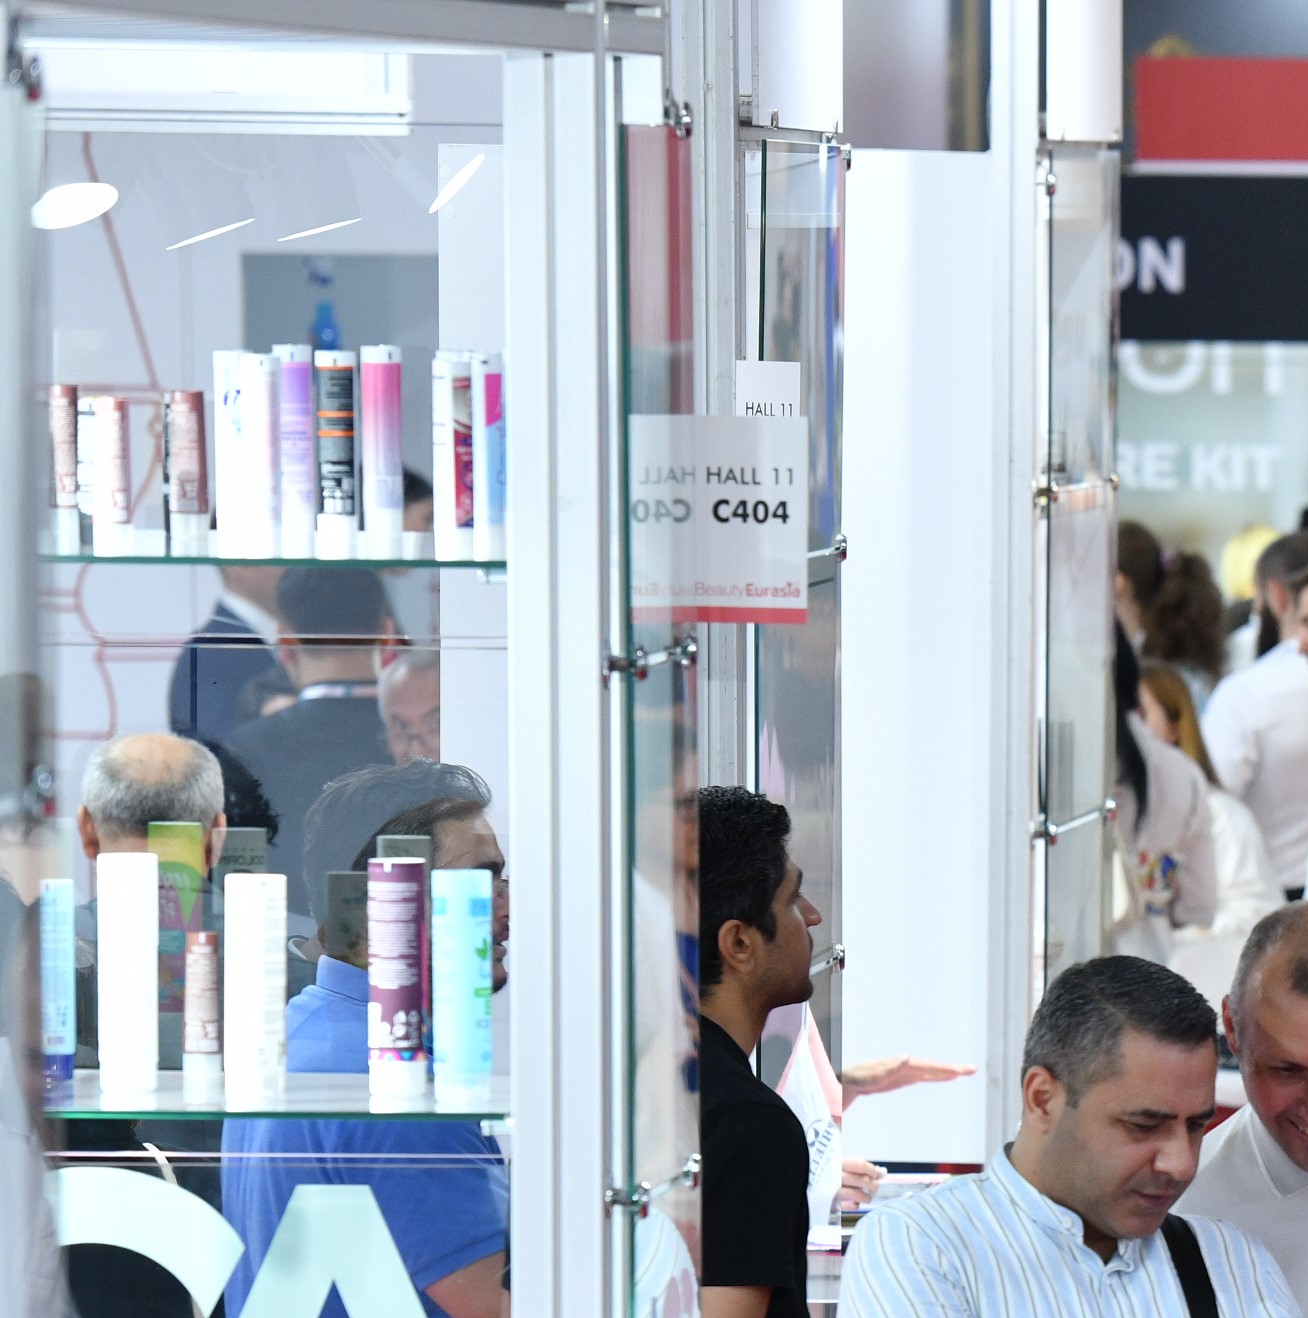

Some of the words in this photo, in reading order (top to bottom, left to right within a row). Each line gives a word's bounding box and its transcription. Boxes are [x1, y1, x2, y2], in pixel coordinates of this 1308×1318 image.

[745, 402, 775, 417] HALL
[780, 403, 793, 417] 11
[706, 466, 761, 485] HALL
[773, 467, 794, 486] 11
[1188, 440, 1282, 492] KIT
[712, 499, 789, 524] C404
